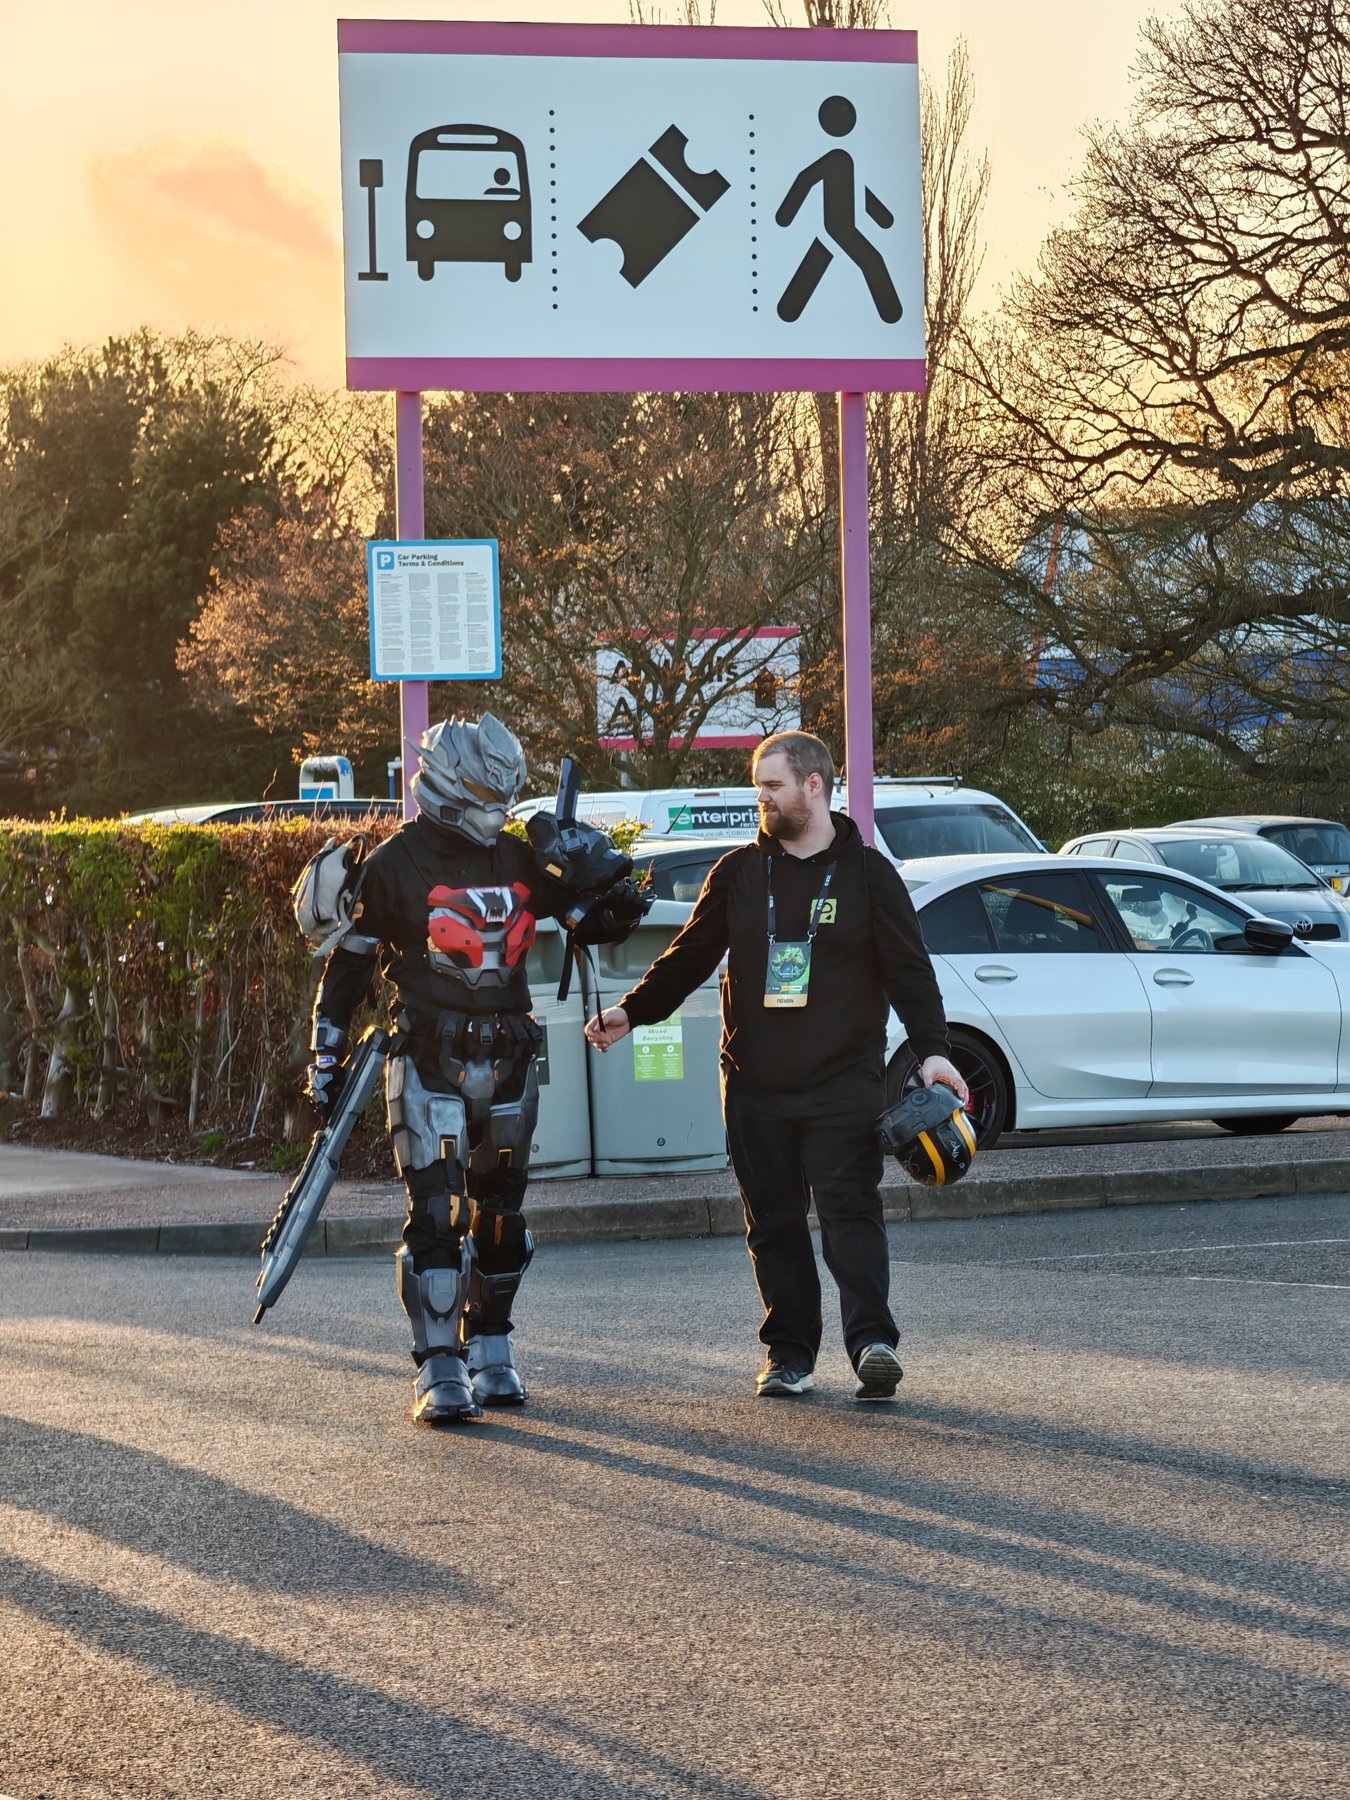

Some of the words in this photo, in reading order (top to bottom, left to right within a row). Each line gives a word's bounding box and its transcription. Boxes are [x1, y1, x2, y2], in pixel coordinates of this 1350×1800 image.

[411, 553, 438, 561] Parking
[427, 559, 464, 567] Conditions
[677, 808, 761, 826] enterpris
